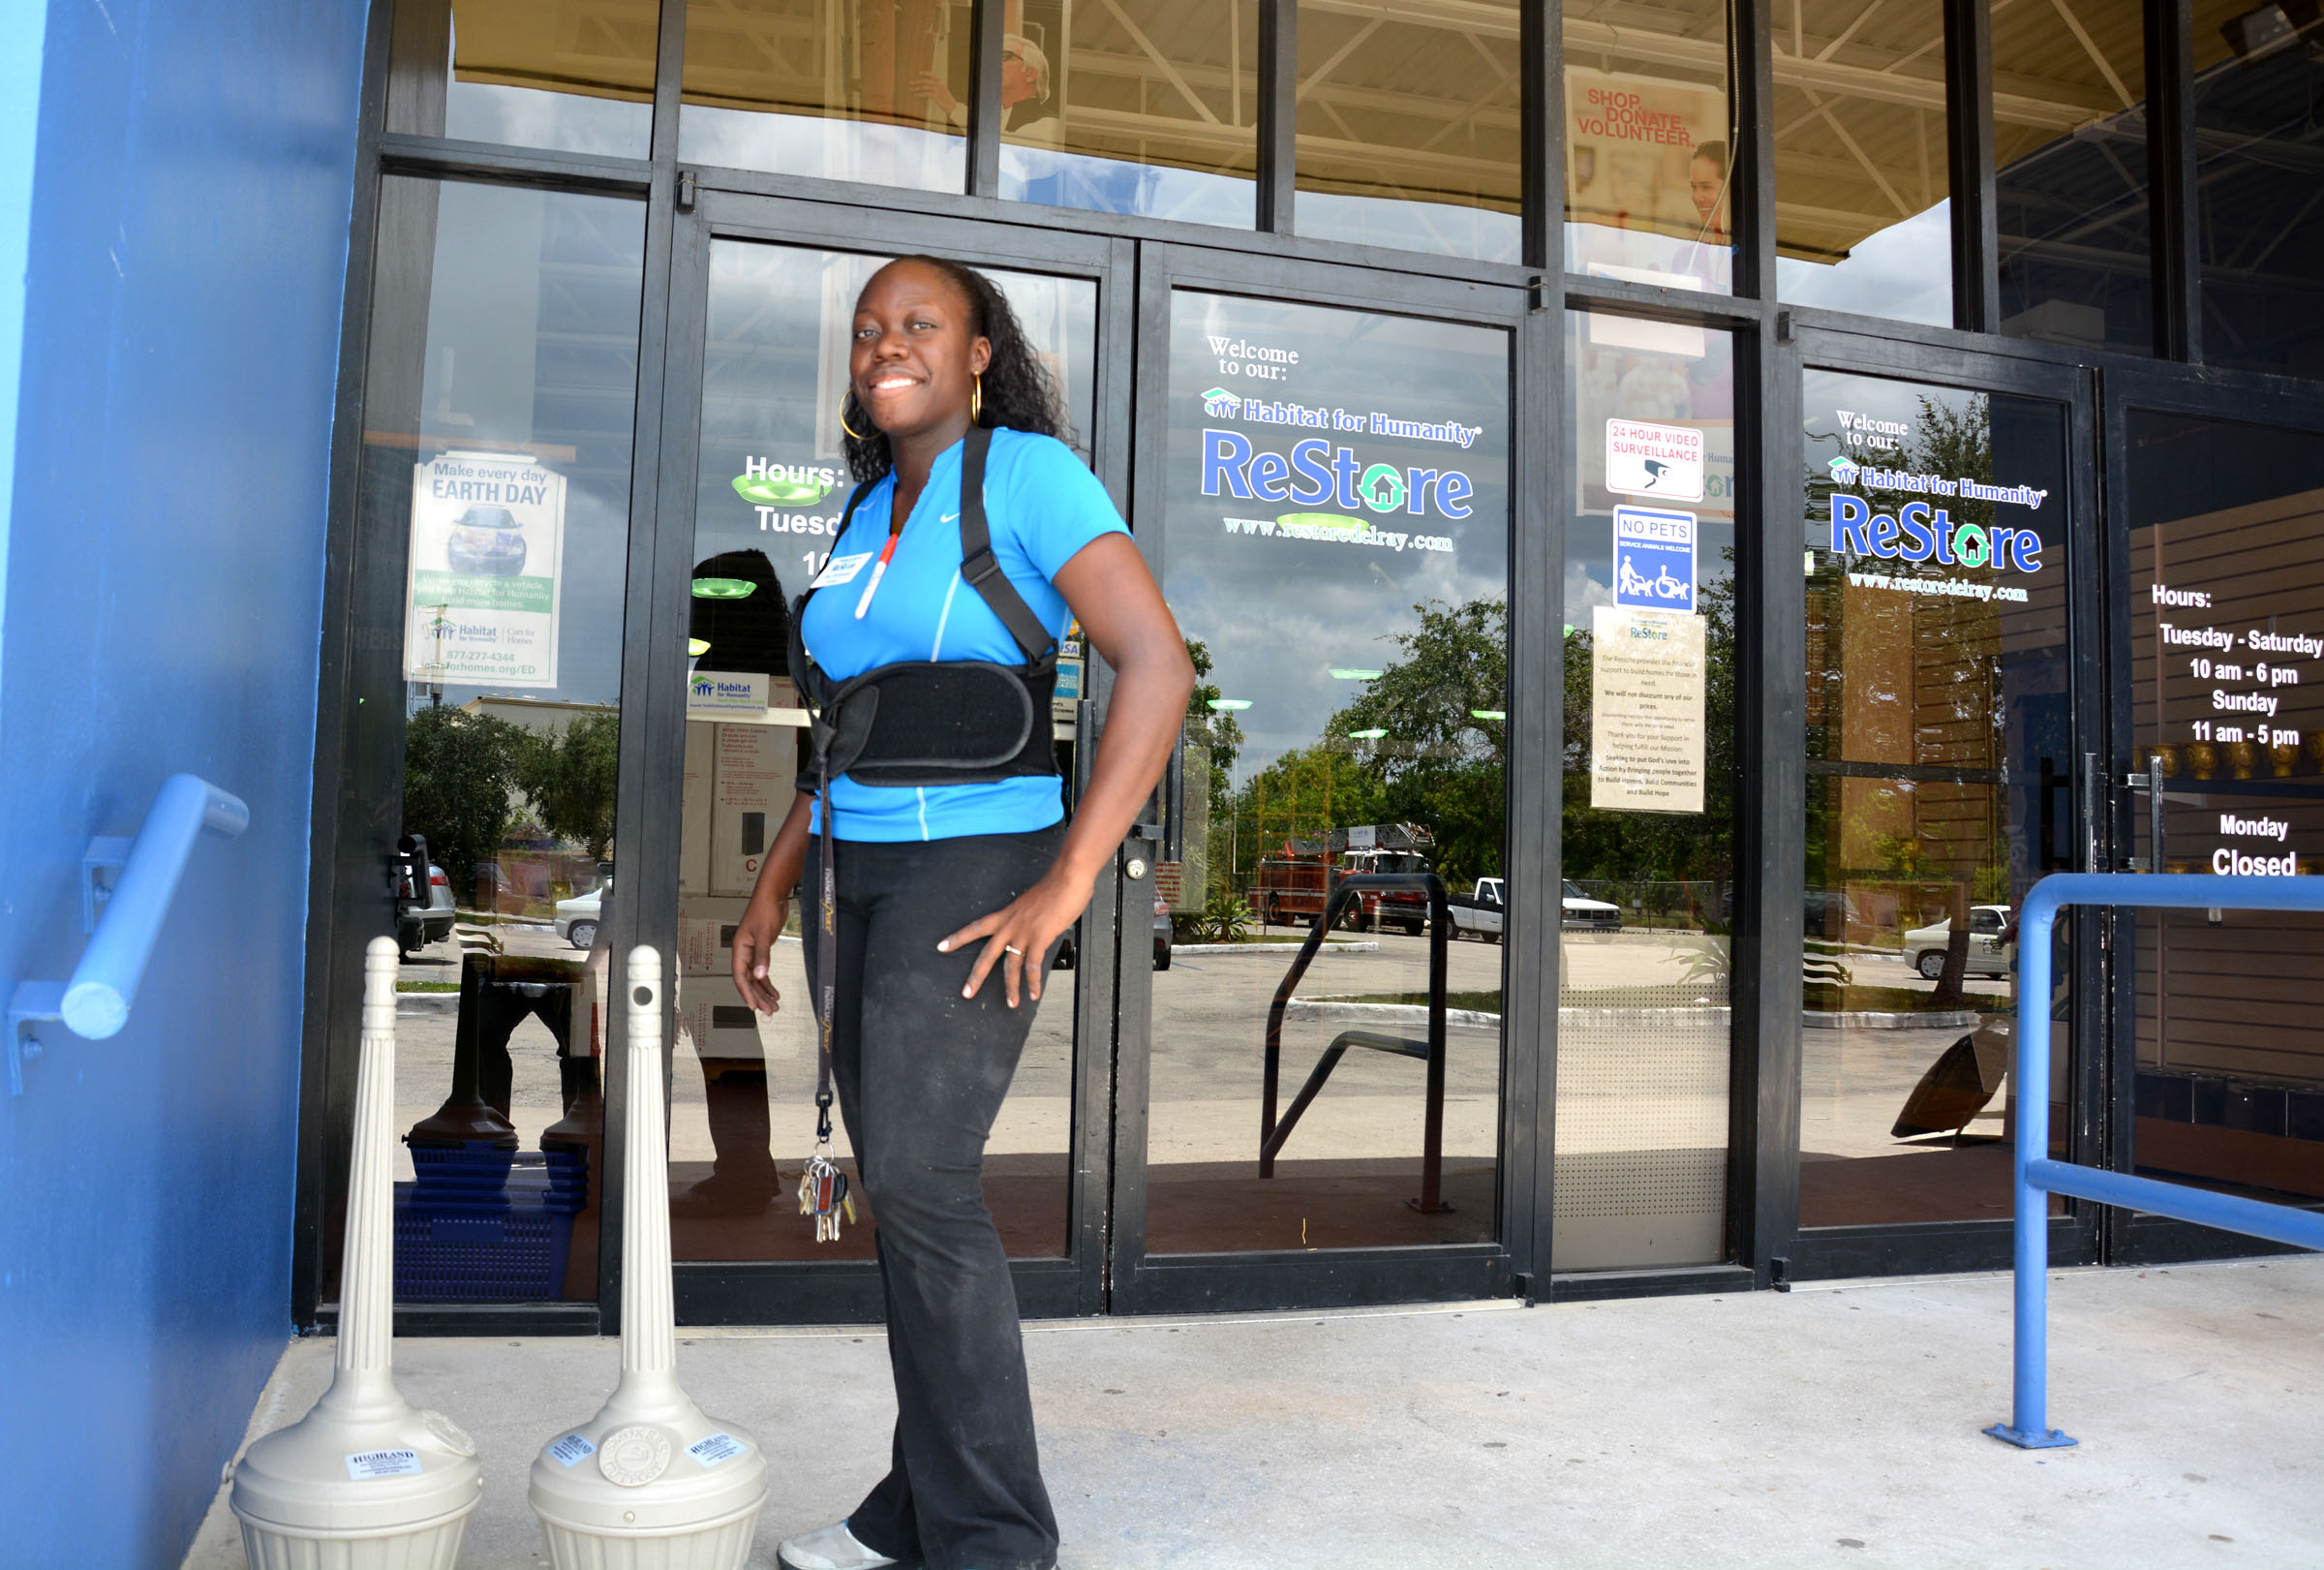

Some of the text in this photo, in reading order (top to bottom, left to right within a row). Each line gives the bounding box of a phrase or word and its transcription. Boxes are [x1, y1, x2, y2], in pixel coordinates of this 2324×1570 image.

[1588, 89, 1642, 110] SHOP.
[1577, 117, 1695, 147] VOLUNTEER.
[1606, 107, 1687, 132] DONATE.
[1208, 335, 1299, 364] Welcome
[1219, 358, 1287, 381] to our:
[1244, 399, 1328, 429] Habitat
[1333, 409, 1365, 432] for
[1836, 410, 1908, 435] Welcome
[1612, 426, 1698, 446] 24 HOUR VIDEO
[1847, 431, 1899, 450] to our:
[1613, 442, 1697, 462] SURVEILLANCE
[435, 464, 547, 484] Make every day
[746, 456, 843, 487] Hours:
[1201, 428, 1473, 519] ReStore
[1862, 467, 1927, 493] Habitat
[1931, 476, 1957, 495] for
[433, 479, 547, 505] EARTH DAY
[1224, 517, 1453, 552] www.restoredelray.com
[1623, 520, 1687, 538] NO PETS
[1830, 493, 2042, 572] ReStore
[1849, 572, 2029, 601] www.restoredelray.com
[2152, 584, 2212, 608] Hours:
[459, 625, 497, 636] Habitat
[1631, 628, 1667, 640] ReStore
[2159, 624, 2233, 652] Tuesday
[2248, 630, 2324, 659] Saturday
[446, 651, 514, 662] 877-277-4344
[2189, 659, 2211, 679] 10
[2215, 663, 2242, 681] am
[2256, 663, 2267, 682] 6
[2271, 667, 2298, 687] pm
[718, 682, 750, 692] Habitat
[2213, 690, 2278, 717] Sunday
[2192, 721, 2211, 741] 11
[2216, 725, 2243, 742] am
[2257, 724, 2268, 744] 5
[2273, 729, 2299, 749] pm
[2220, 814, 2288, 842] Monday
[746, 859, 757, 872] C
[2213, 848, 2296, 877] Closed
[353, 1452, 413, 1463] HIGHLAND
